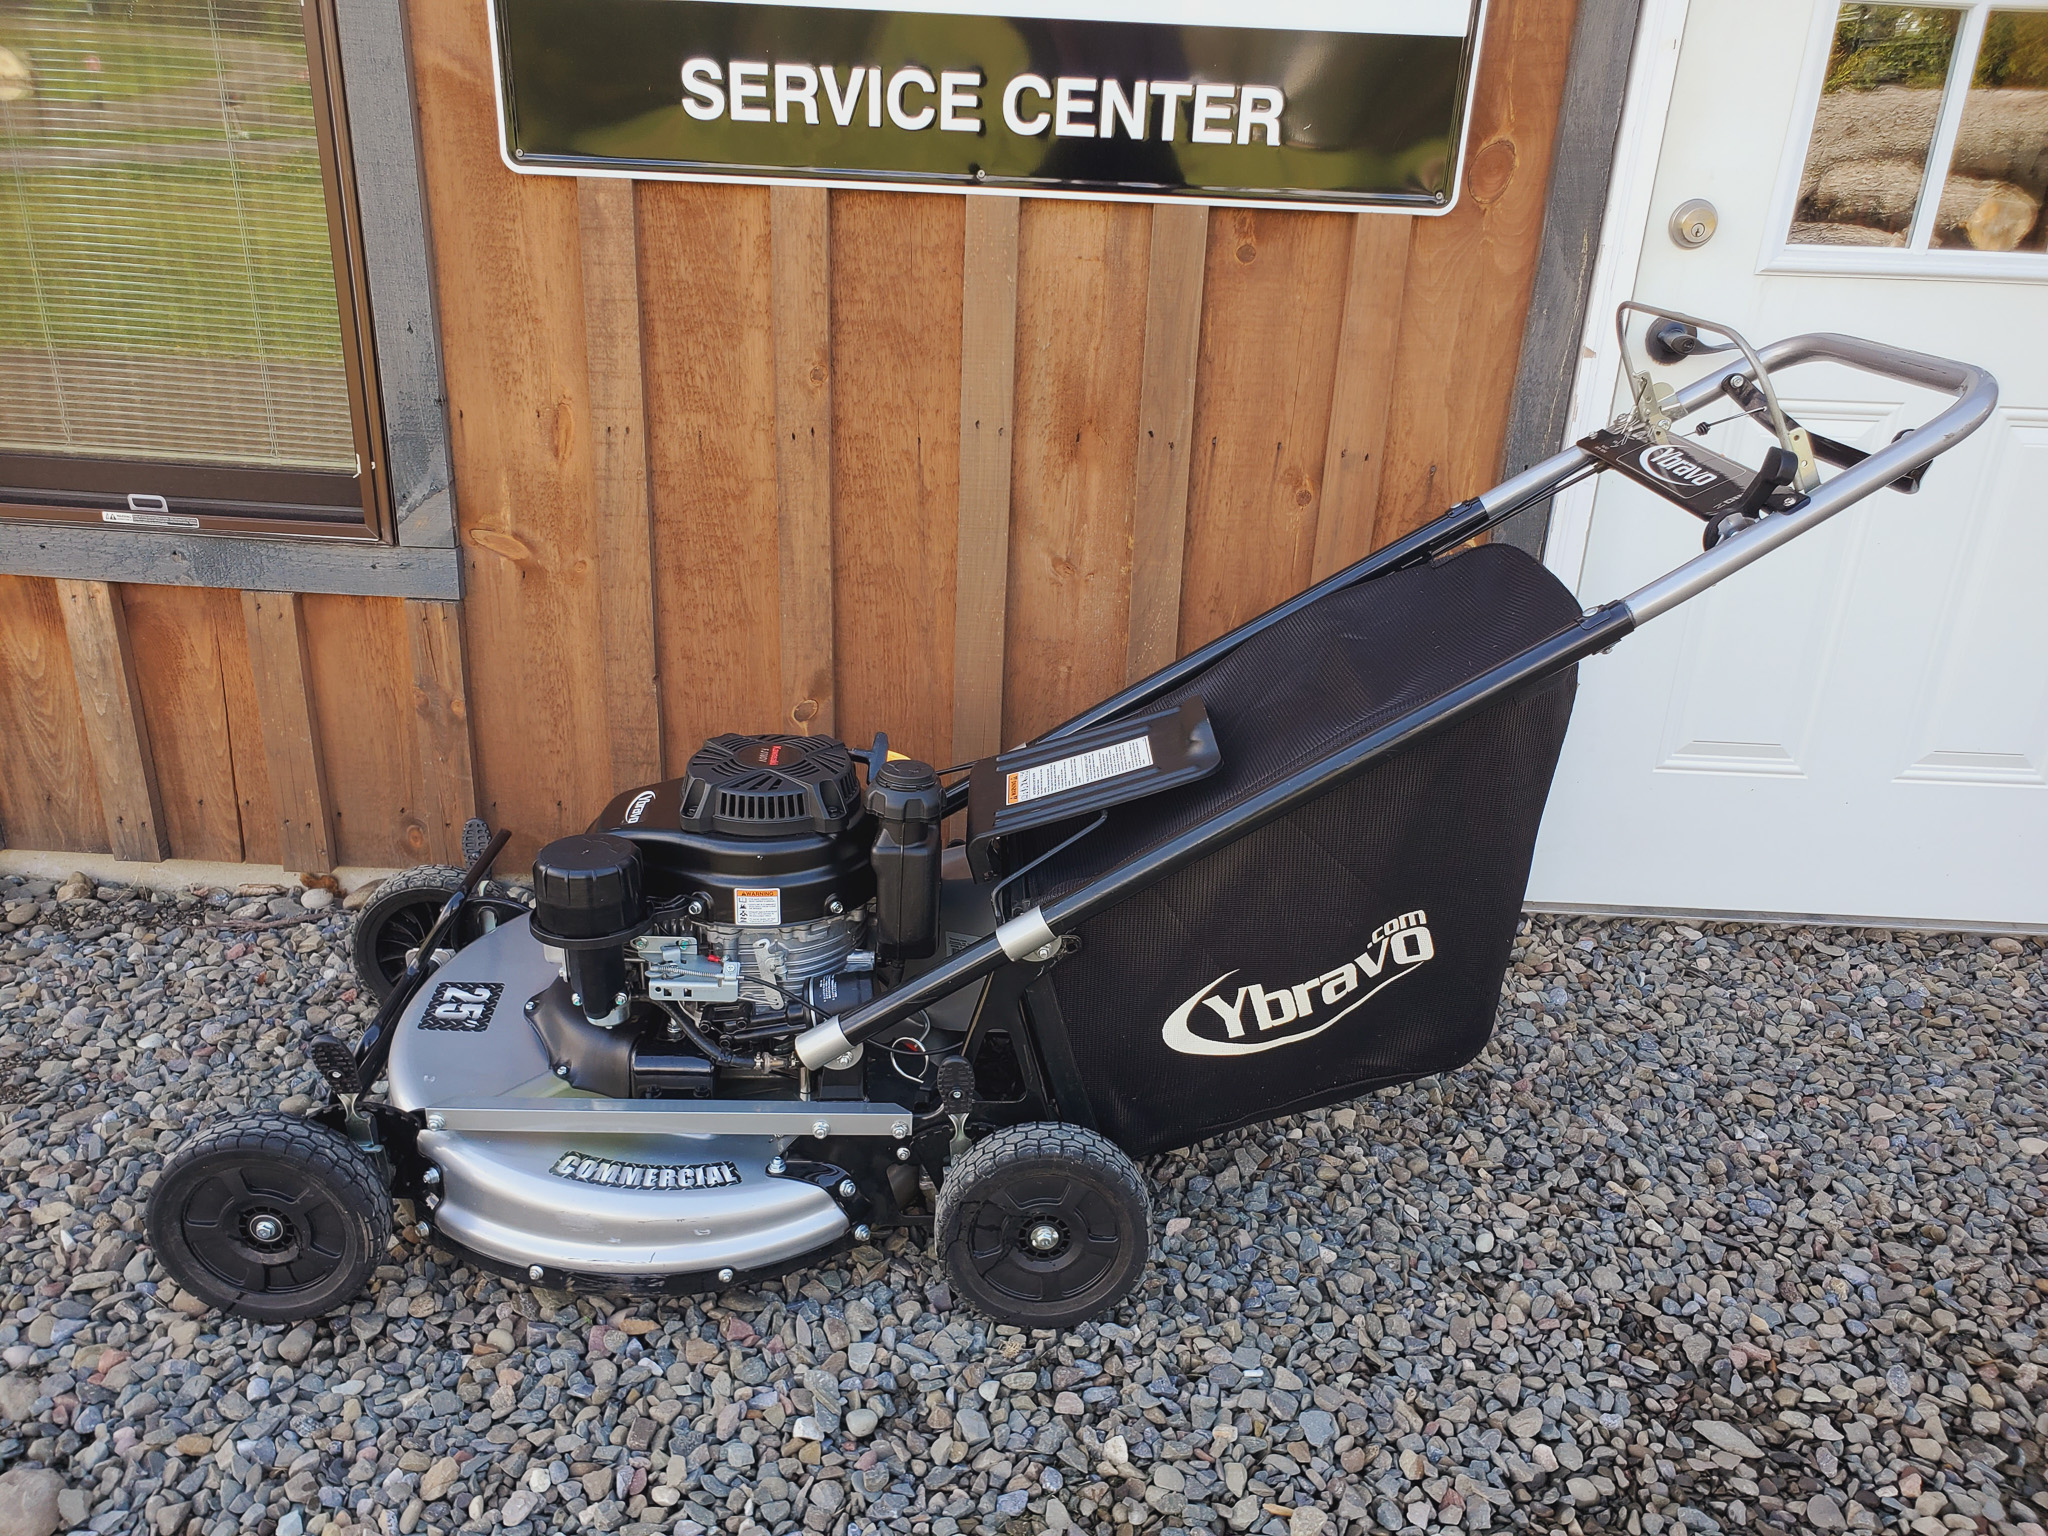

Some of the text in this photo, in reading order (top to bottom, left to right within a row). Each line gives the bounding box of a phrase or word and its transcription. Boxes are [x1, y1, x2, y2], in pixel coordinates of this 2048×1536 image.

[680, 58, 1287, 147] SERVICE CENTER
[1650, 447, 1718, 487] Ybravo
[1201, 926, 1435, 1039] Ybravo
[558, 1155, 738, 1188] COMMERCIAL
